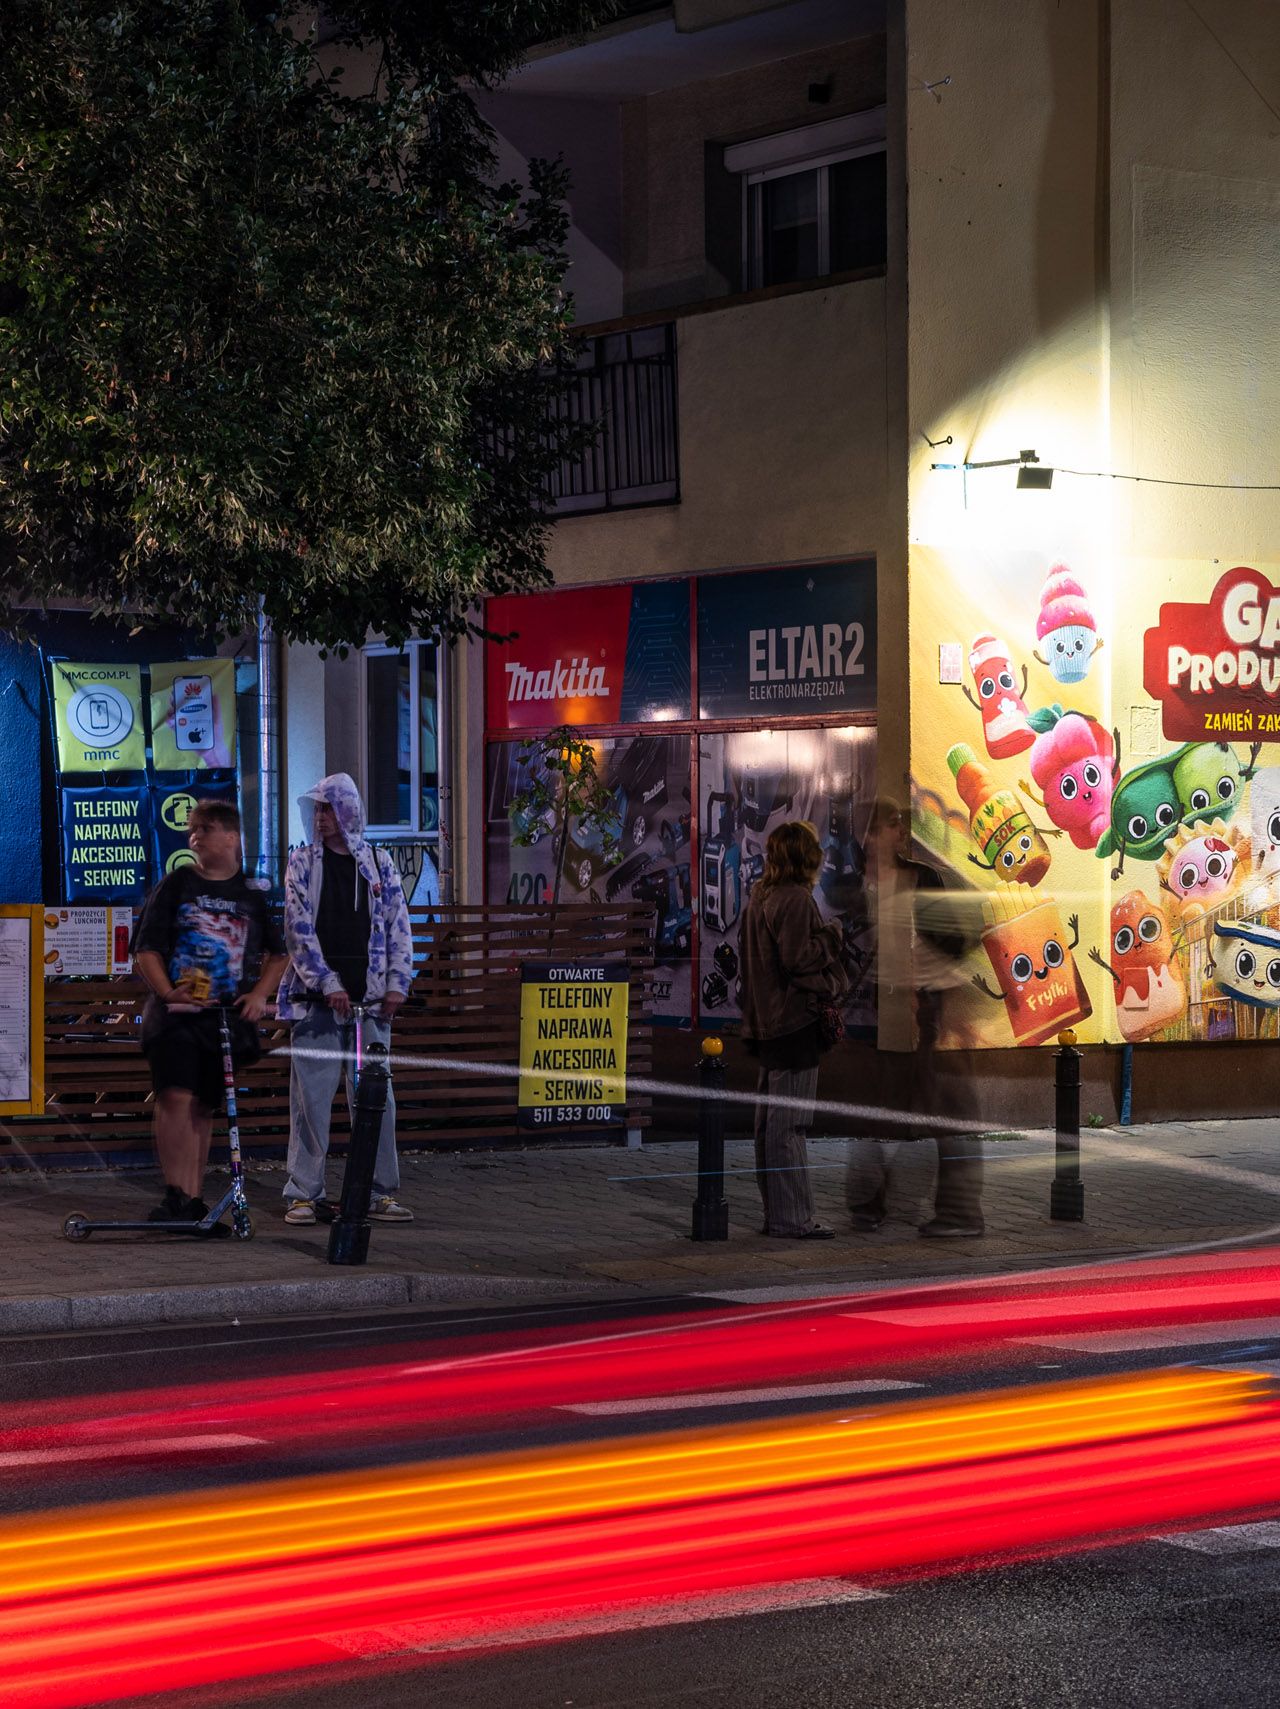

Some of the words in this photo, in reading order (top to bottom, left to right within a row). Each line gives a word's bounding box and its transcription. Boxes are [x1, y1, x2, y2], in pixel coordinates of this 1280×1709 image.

[749, 622, 865, 683] ELTAR2
[62, 670, 132, 681] MMC.COM.PL
[749, 680, 845, 702] ELEKTRONARZĘDZIA
[1204, 709, 1253, 732] ZAMIEŃ
[84, 750, 121, 761] mmc
[73, 800, 139, 818] TELEFONY
[74, 823, 141, 841] NAPRAWA
[993, 820, 1017, 847] SOK
[71, 846, 147, 864] AKCESORIA
[84, 868, 136, 887] SERWIS
[549, 968, 605, 981] OTWARTE
[539, 988, 613, 1009] TELEFONY
[1026, 982, 1068, 1011] Frytki
[538, 1018, 613, 1039] NAPRAWA
[533, 1048, 617, 1070] AKCESORIA
[545, 1079, 603, 1101] SERWIS
[533, 1108, 552, 1123] 511
[557, 1107, 582, 1122] 533
[586, 1106, 612, 1121] 000
